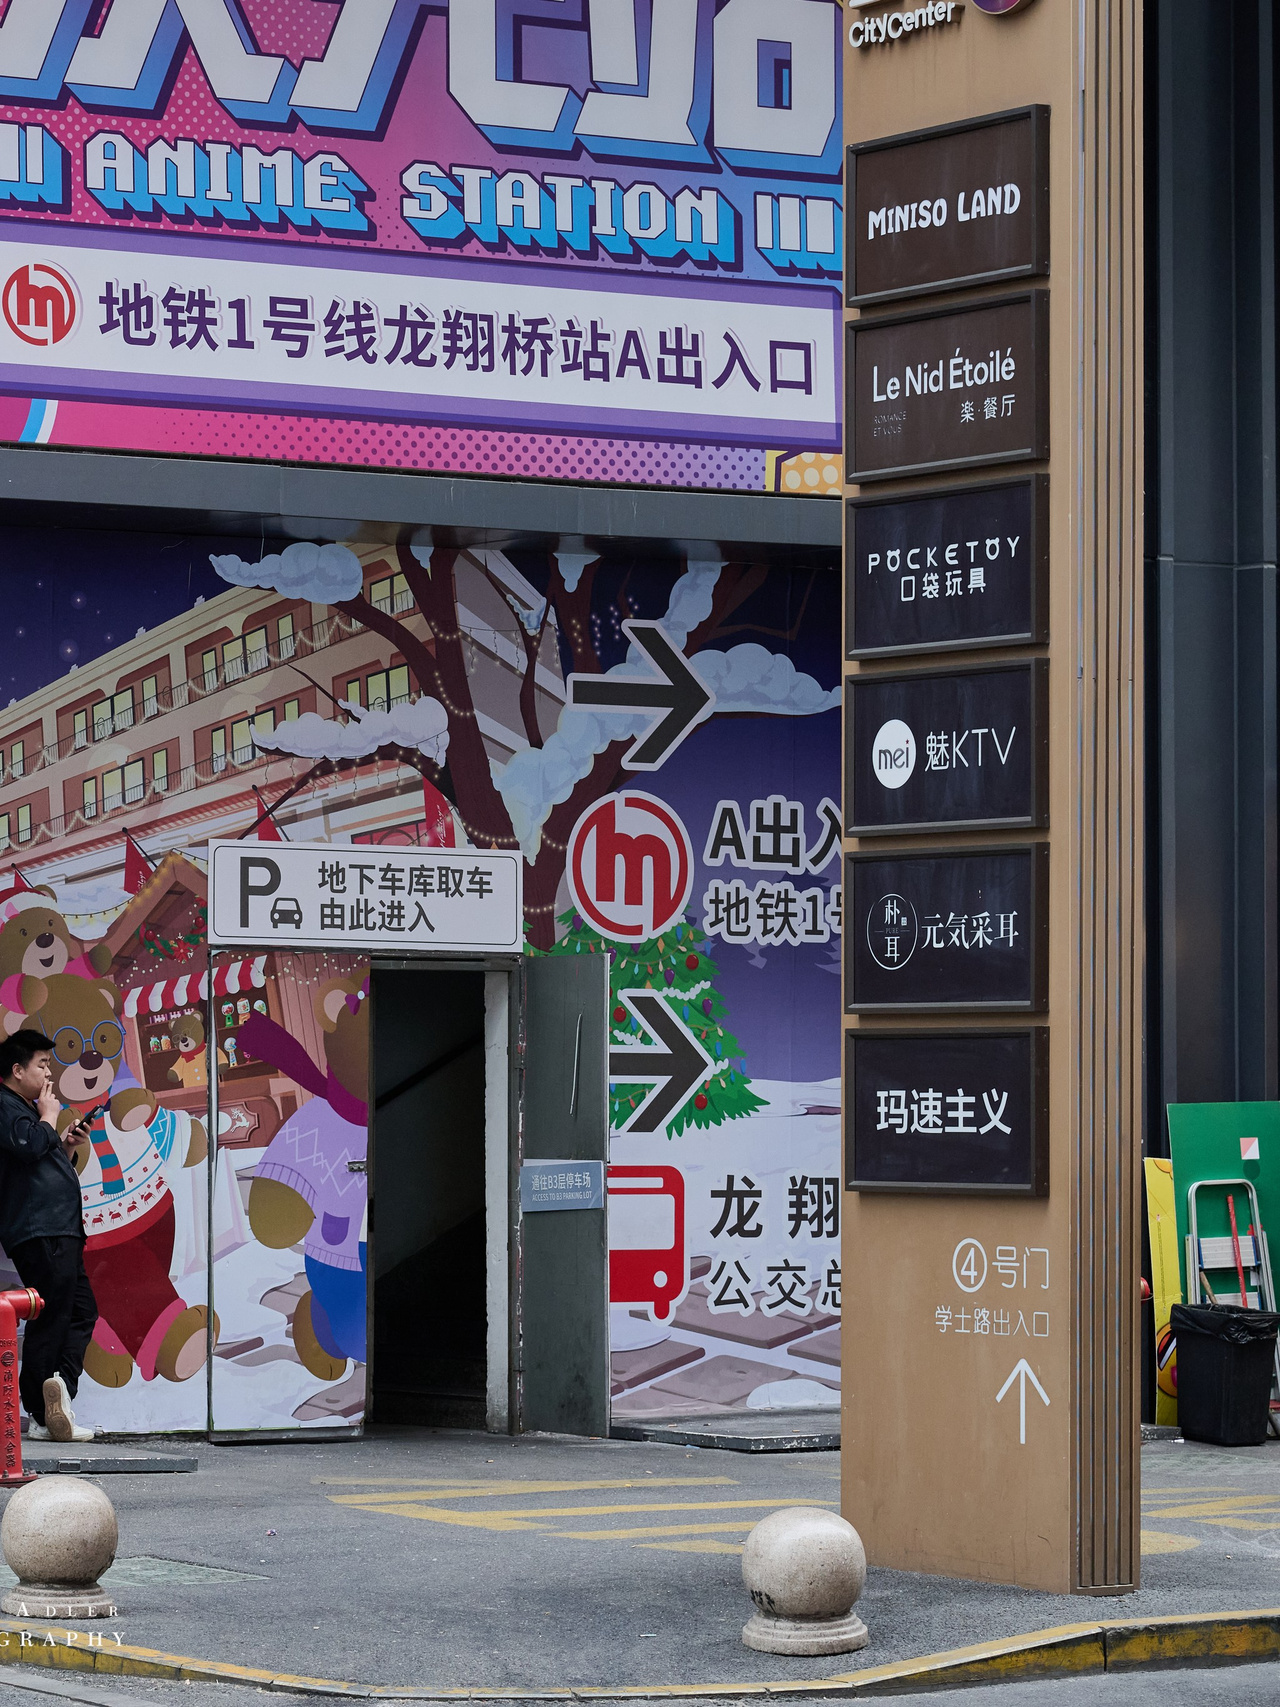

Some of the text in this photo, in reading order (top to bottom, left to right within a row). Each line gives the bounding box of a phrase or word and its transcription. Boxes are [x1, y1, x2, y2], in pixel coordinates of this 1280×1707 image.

[85, 129, 732, 258] ANIME STATION
[867, 183, 1021, 240] MINISO LAND
[99, 281, 813, 396] 地铁1号线龙翔桥站A出入口
[873, 347, 1015, 402] Le Nid Étoilé
[868, 536, 1020, 575] POCKETOY
[901, 567, 987, 602] 口袋玩具
[924, 726, 1017, 772] 魅KTV
[240, 856, 282, 929] P
[318, 861, 494, 899] 地下车库取车
[320, 897, 436, 933] 由此进入
[708, 886, 841, 938] 地铁1
[876, 1088, 1012, 1135] 玛速主义
[531, 1172, 591, 1191] 通往B3层停车场
[532, 1191, 592, 1202] ACCESS TO B3 PARKING LOT
[934, 1305, 1050, 1337] 学士路出入口
[2, 1368, 17, 1468] 消防水泵接合器
